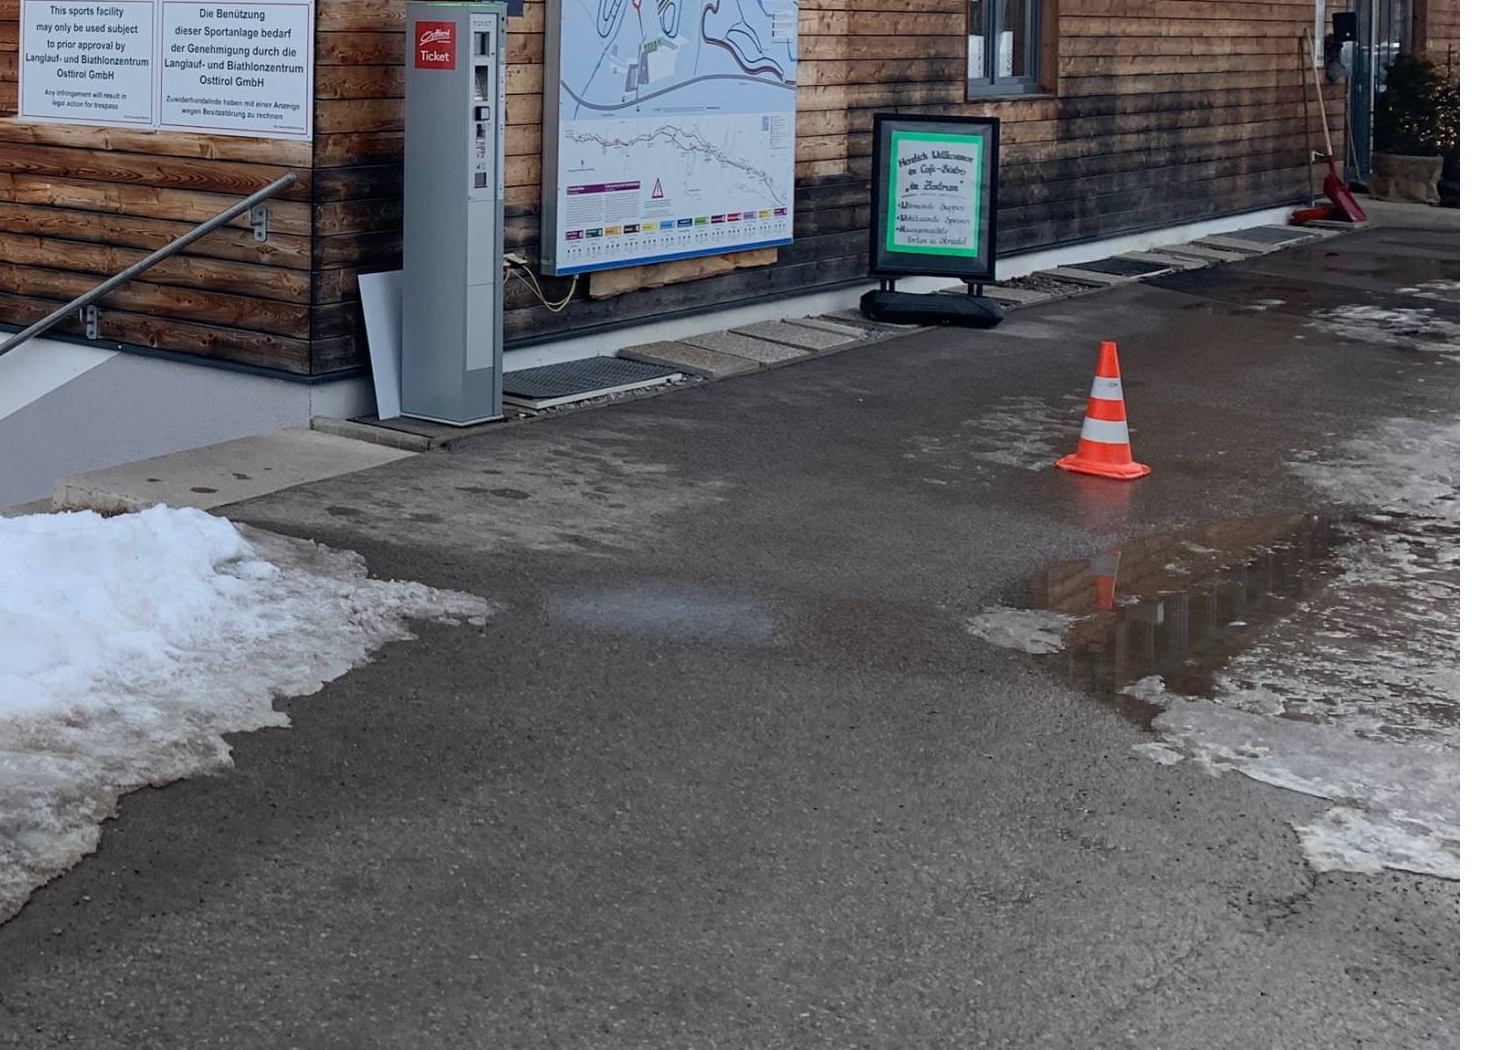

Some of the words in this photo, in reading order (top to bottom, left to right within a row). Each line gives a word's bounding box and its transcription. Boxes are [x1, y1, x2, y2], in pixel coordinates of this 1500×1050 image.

[50, 6, 67, 15] This
[69, 7, 94, 17] sports
[96, 6, 124, 18] facility
[199, 9, 214, 18] Die
[216, 9, 265, 21] Benützung
[36, 24, 52, 33] may
[55, 23, 71, 34] only
[74, 23, 83, 32] be
[86, 24, 105, 33] used
[108, 25, 138, 35] subject
[175, 26, 201, 36] dieser
[204, 27, 258, 39] Sportanlage
[261, 28, 292, 38] bedarf
[47, 40, 54, 48] to
[57, 40, 76, 50] prior
[78, 41, 113, 51] approval
[116, 41, 125, 53] by
[171, 43, 185, 53] der
[187, 44, 250, 57] Genehmigung
[252, 46, 280, 56] durch
[282, 47, 297, 57] die
[26, 53, 62, 63] Langlauf-
[64, 55, 79, 63] und
[81, 55, 149, 66] Biathlonzentrum
[420, 50, 450, 62] Ticket
[165, 58, 205, 70] Langlauf-
[208, 61, 224, 70] und
[227, 61, 303, 73] Biathlonzentrum
[57, 69, 86, 79] Osttirol
[89, 70, 114, 80] GmbH
[200, 75, 233, 86] Osttirol
[236, 77, 264, 87] GmbH
[44, 89, 55, 97] Any
[57, 90, 91, 98] infringement
[94, 102, 118, 110] trespass
[223, 97, 243, 106] haben
[244, 99, 254, 107] mit
[273, 102, 300, 111] Anzeige
[203, 108, 245, 119] Besitzstörung
[257, 112, 283, 120] rechnen
